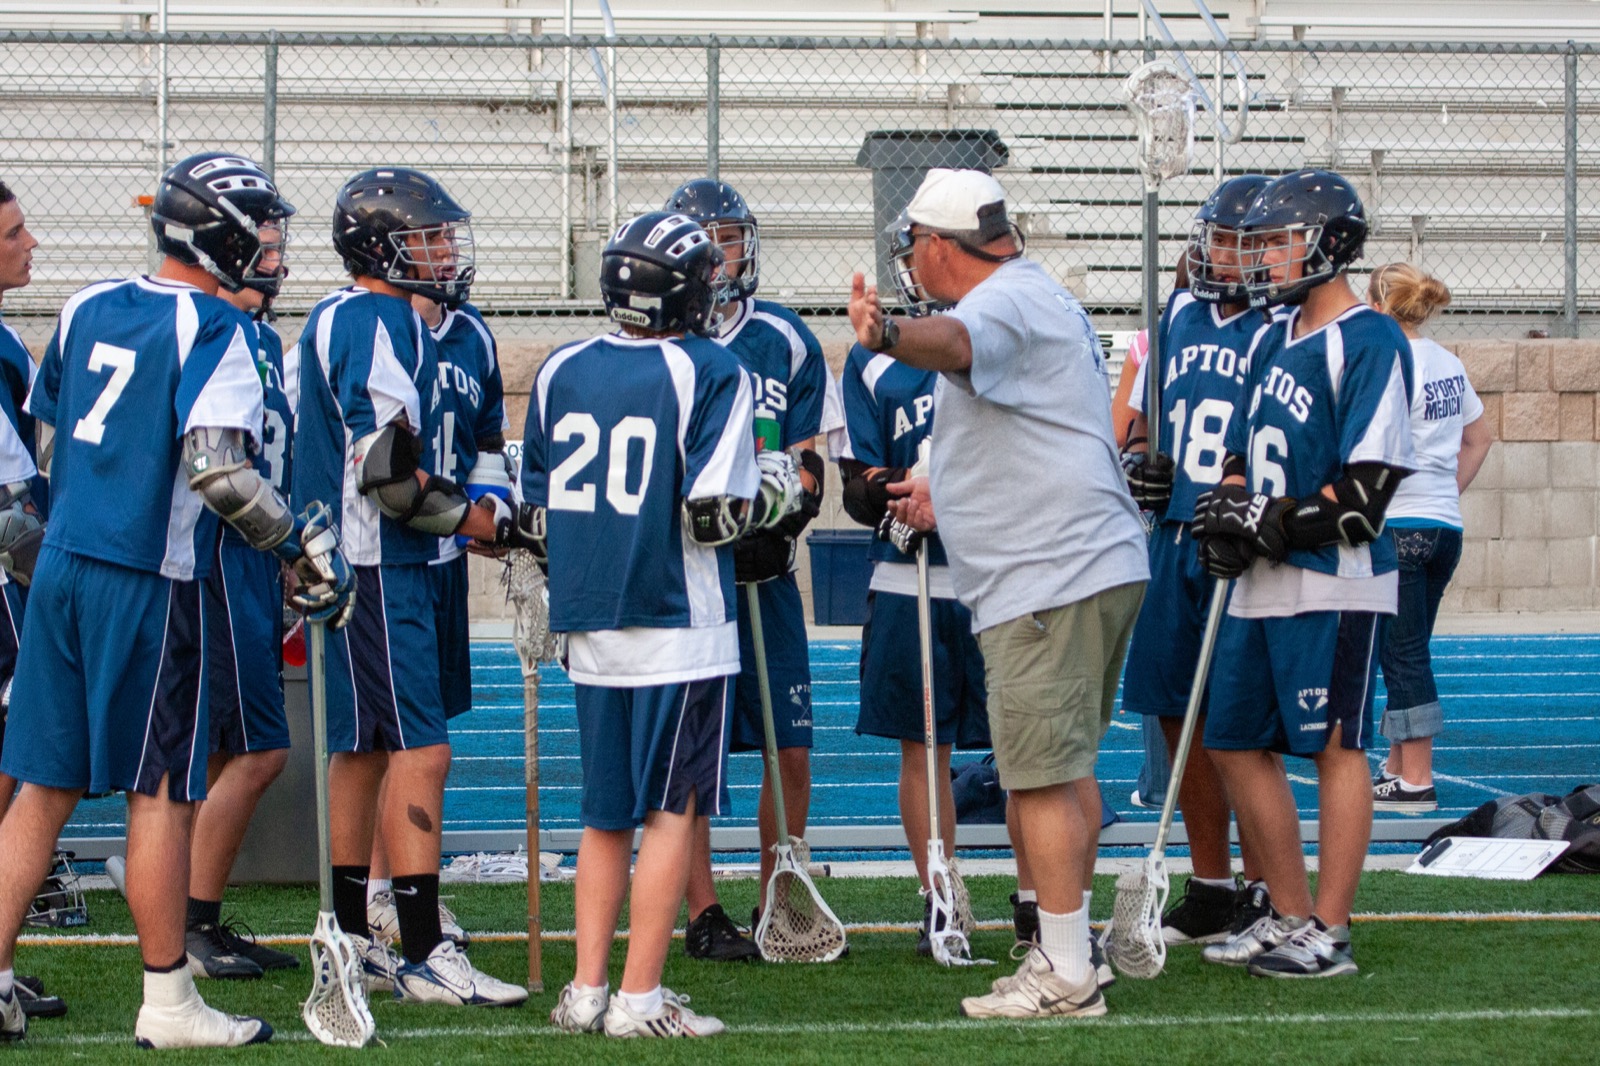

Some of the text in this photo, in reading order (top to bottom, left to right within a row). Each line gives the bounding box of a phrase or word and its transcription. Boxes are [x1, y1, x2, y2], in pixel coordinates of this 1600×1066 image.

[614, 310, 646, 324] Riddell
[73, 341, 137, 446] 7
[430, 361, 481, 410] ATOS
[1423, 374, 1466, 402] SPORTS
[547, 411, 657, 516] 20
[1168, 398, 1234, 485] 18
[1243, 493, 1269, 533] STX
[1298, 687, 1328, 698] APTOS
